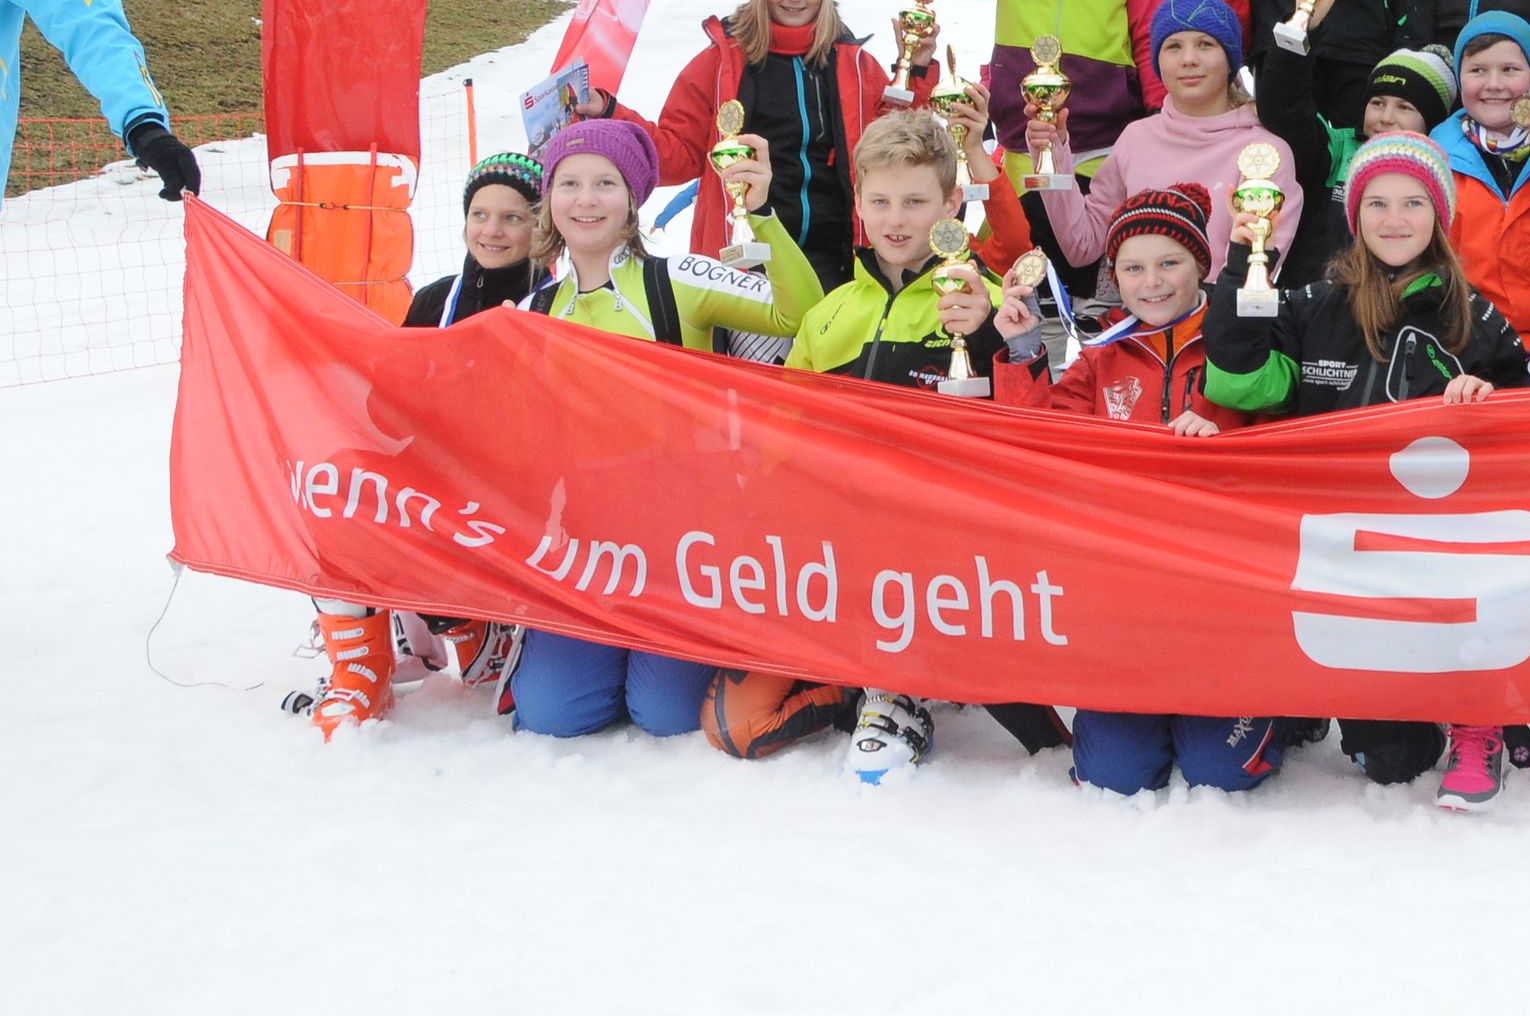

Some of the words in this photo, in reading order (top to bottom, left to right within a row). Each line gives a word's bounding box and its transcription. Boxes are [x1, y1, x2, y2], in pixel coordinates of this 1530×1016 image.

[678, 255, 767, 293] BOGNER
[1318, 359, 1346, 369] SPORT
[524, 534, 648, 597] um
[674, 529, 839, 624] Geld
[871, 554, 1069, 654] geht
